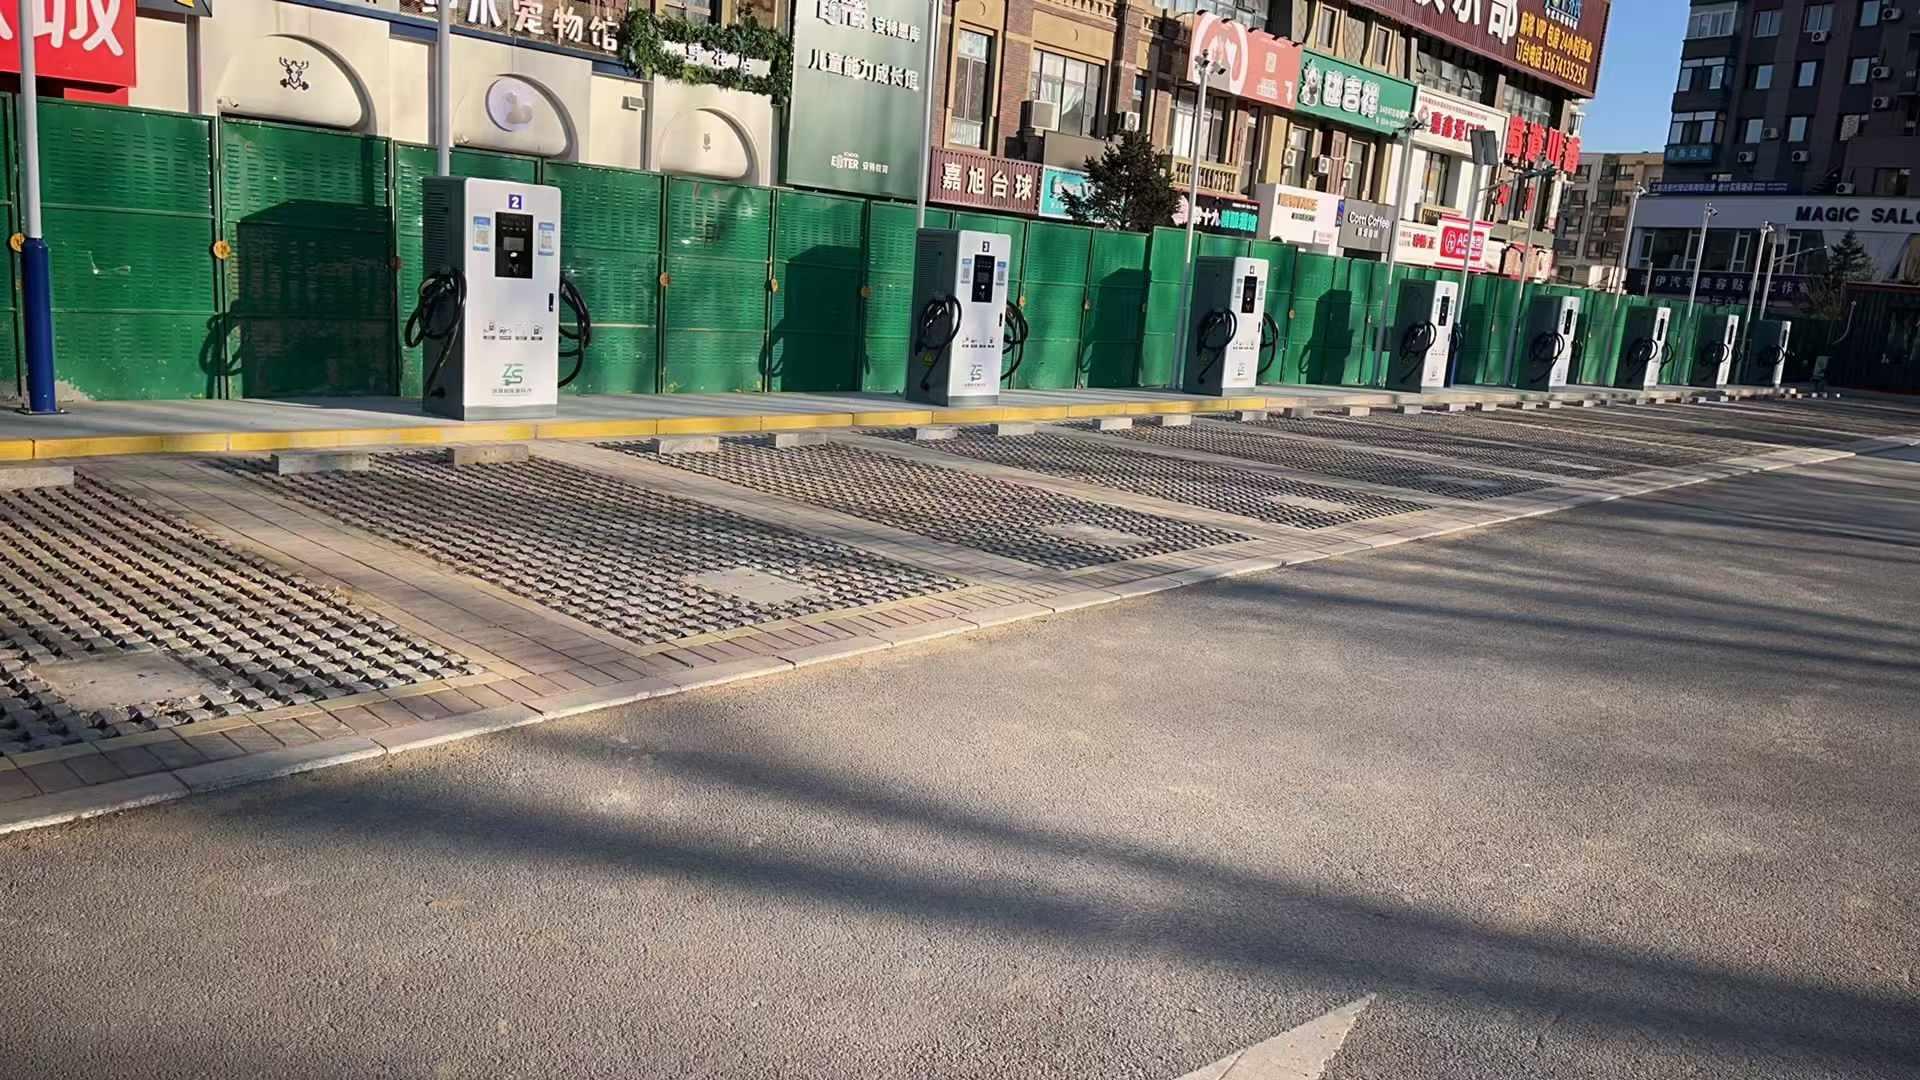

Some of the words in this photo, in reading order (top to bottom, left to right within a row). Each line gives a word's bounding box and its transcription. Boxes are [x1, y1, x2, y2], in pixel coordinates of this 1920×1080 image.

[808, 48, 919, 91] 儿童能力成长馆
[942, 162, 1033, 200] 嘉旭台球
[511, 196, 520, 209] 2
[1367, 214, 1390, 229] Coffee
[1795, 206, 1859, 223] MAGIC
